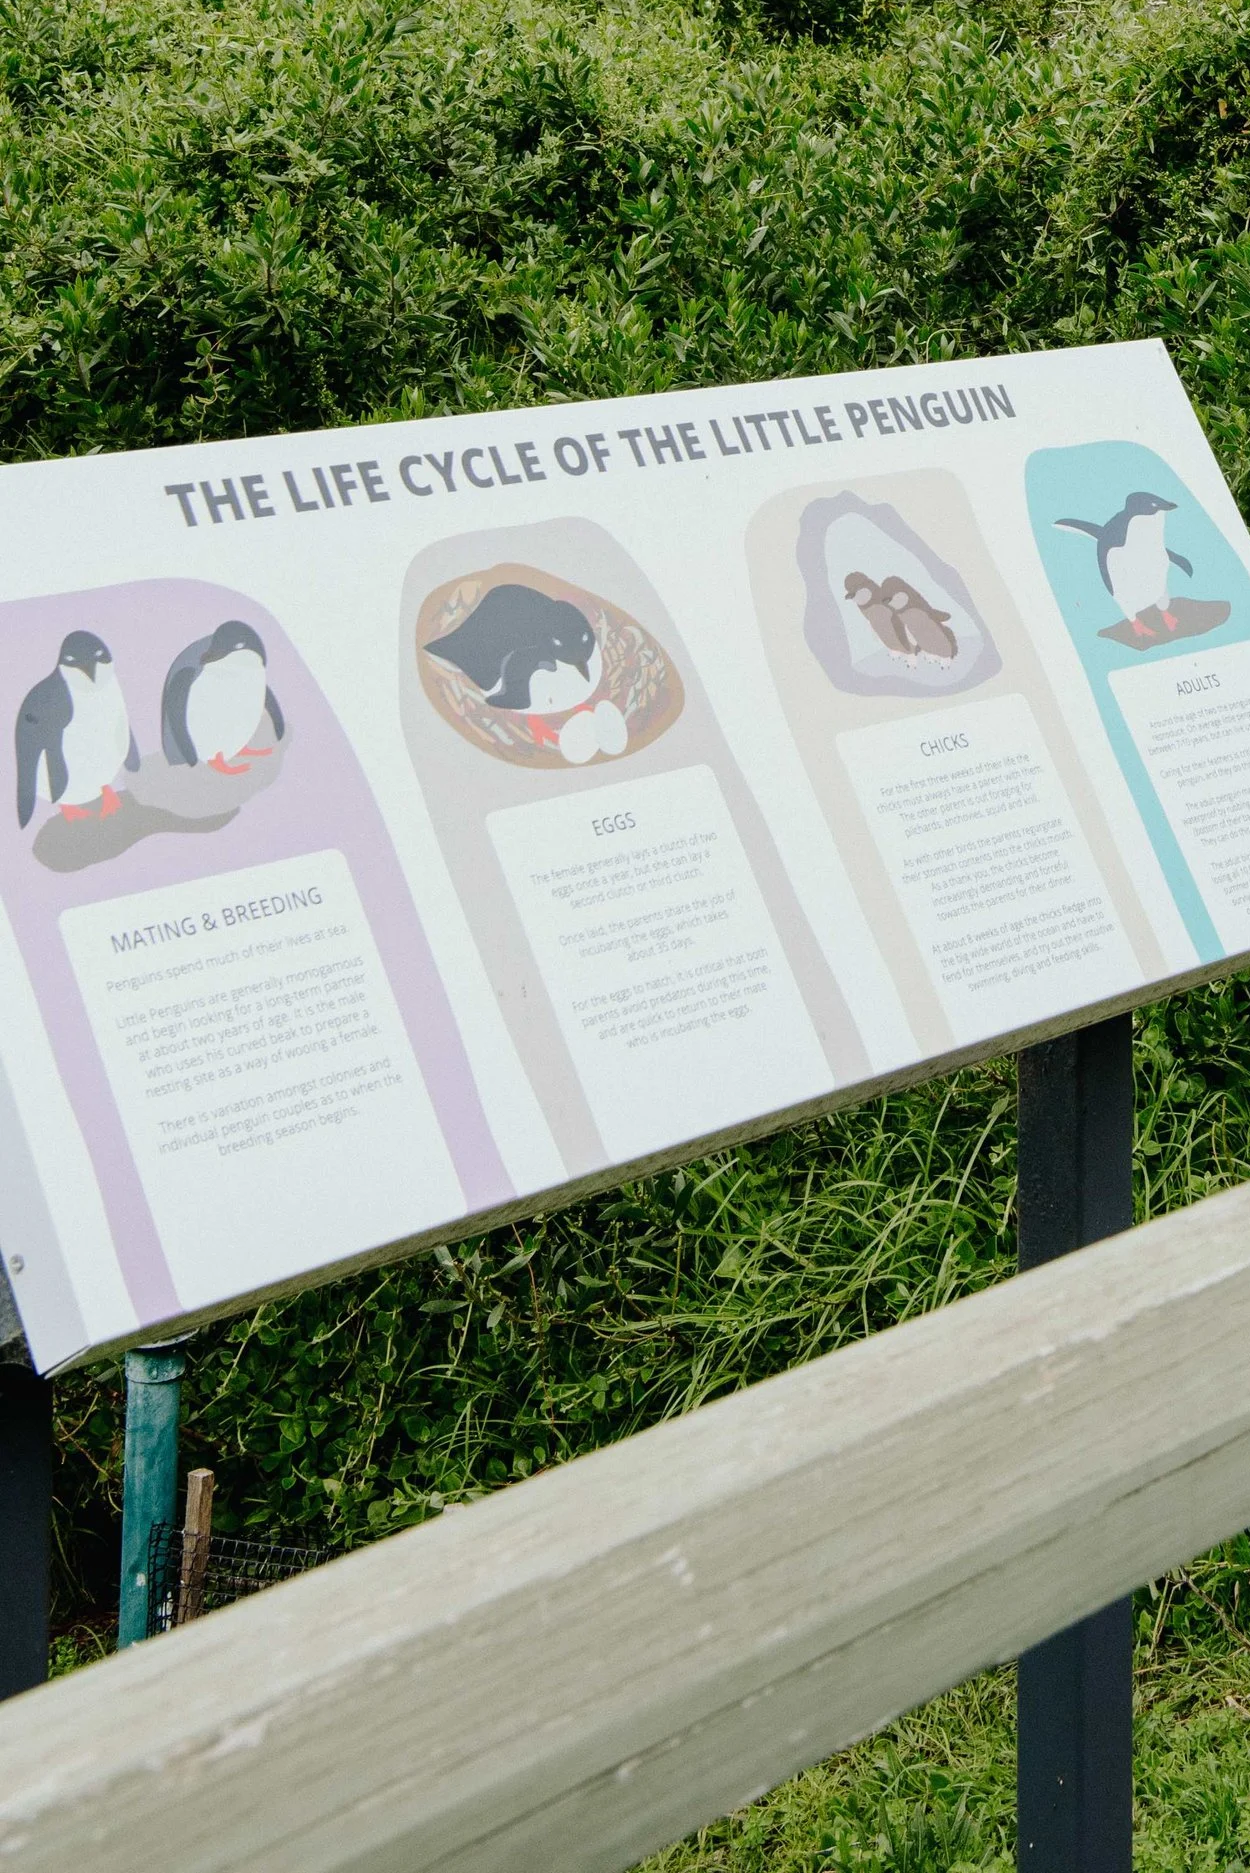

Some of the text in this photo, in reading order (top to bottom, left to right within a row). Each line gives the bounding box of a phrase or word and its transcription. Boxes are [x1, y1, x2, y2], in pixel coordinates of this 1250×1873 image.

[164, 383, 1016, 528] THE LIFE CYCLE OF THE LITTLE PENGUIN
[1176, 673, 1220, 696] ADULTS
[879, 754, 1030, 797] For the first three weeks of their life the
[920, 732, 968, 757] CHICKS
[592, 810, 635, 836] EGGS
[529, 872, 550, 885] The
[550, 863, 585, 880] female
[586, 852, 628, 874] generally
[629, 848, 649, 862] lays
[658, 837, 687, 853] clutch
[688, 833, 698, 846] of
[698, 832, 716, 843] two
[570, 866, 703, 909] second clutch or third clutch.
[111, 885, 322, 953] MATING & BREEDING
[932, 944, 942, 955] At
[942, 936, 966, 951] about
[972, 927, 997, 942] weeks
[998, 922, 1006, 934] of
[1007, 921, 1022, 933] age
[1021, 916, 1037, 927] the
[1037, 908, 1061, 922] chicks
[1060, 902, 1086, 915] fledge
[1084, 897, 1101, 908] into
[106, 925, 349, 992] Penguins spend much of their lives at sea.
[968, 942, 1102, 991] swimming, diving and feeding skills.
[115, 956, 363, 1029] Little Penguins are generally monogamous
[125, 1028, 150, 1046] and
[151, 1020, 187, 1038] begin
[188, 1009, 234, 1028] looking
[234, 1003, 251, 1016] for
[264, 985, 322, 1008] long-term
[323, 973, 364, 996] partner
[138, 990, 365, 1061] at about two years of age. It is the male
[581, 966, 771, 1031] parents avoid predators during this time,
[144, 1064, 172, 1079] who
[174, 1055, 204, 1070] uses
[204, 1048, 224, 1062] his
[226, 1034, 267, 1056] curved
[268, 1026, 299, 1044] beak
[298, 1025, 312, 1036] to
[314, 1012, 360, 1035] prepare
[146, 1078, 193, 1099] nesting
[194, 1071, 216, 1085] site
[218, 1066, 233, 1078] as
[244, 1056, 267, 1070] way
[271, 1048, 282, 1063] of
[284, 1039, 328, 1059] wooing
[338, 1024, 380, 1044] female.
[158, 1055, 390, 1134] There is variation amongst colonies and
[158, 1073, 403, 1154] individual penguin couples as to when the
[217, 1106, 359, 1156] breeding season begins.
